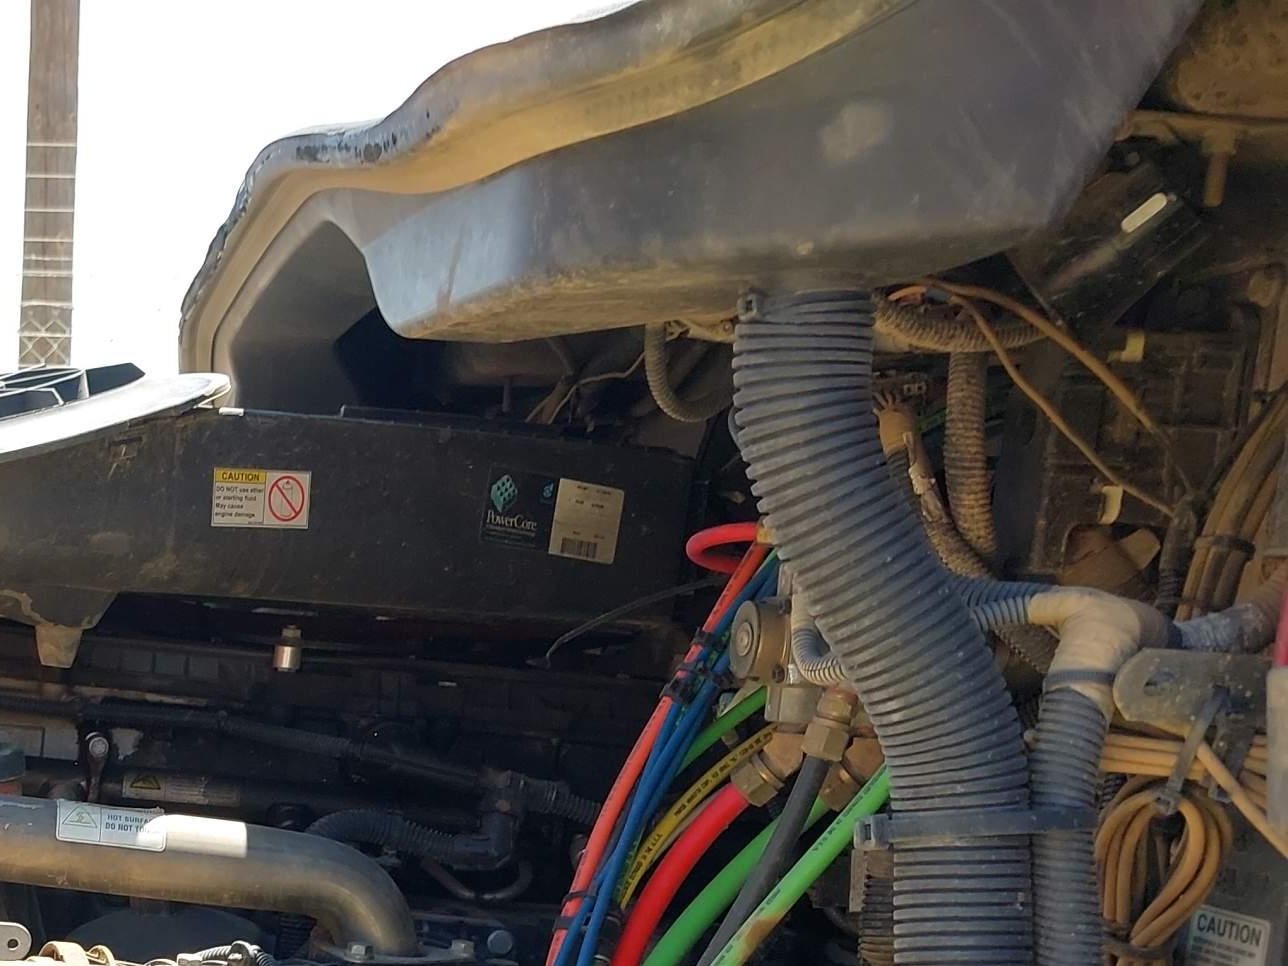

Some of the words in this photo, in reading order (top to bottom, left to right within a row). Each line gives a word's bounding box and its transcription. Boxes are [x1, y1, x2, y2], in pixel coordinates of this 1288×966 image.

[222, 472, 260, 481] CAUTION
[107, 813, 123, 822] HOT
[125, 815, 153, 825] SURFA
[105, 822, 116, 831] DO
[118, 824, 134, 833] NOT
[1196, 913, 1263, 947] CAUTION
